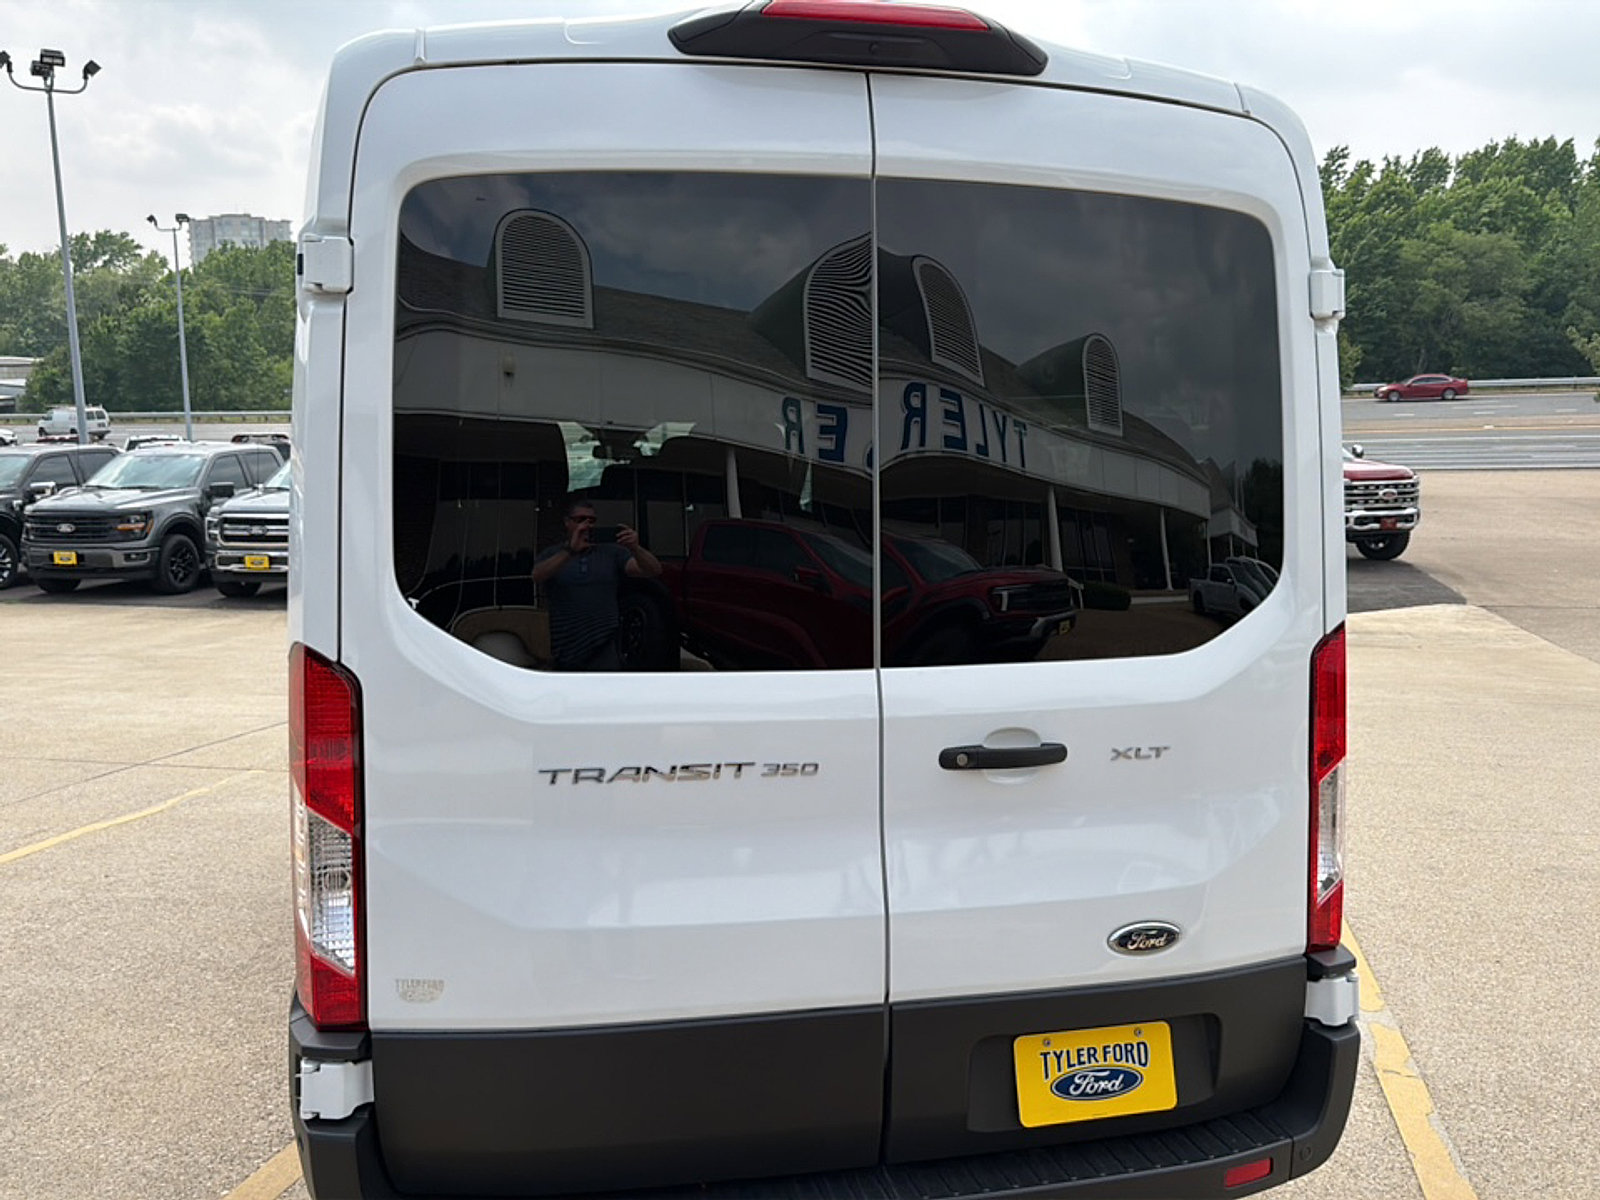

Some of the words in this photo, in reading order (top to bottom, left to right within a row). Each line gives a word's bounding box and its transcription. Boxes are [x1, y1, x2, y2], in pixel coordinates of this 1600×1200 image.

[1110, 746, 1170, 761] XLT
[538, 762, 756, 785] TRANSIT
[760, 763, 819, 778] 350
[1127, 929, 1168, 950] Ford
[1040, 1046, 1099, 1080] TYLER
[1102, 1041, 1150, 1067] FORD
[1069, 1070, 1124, 1096] Ford
